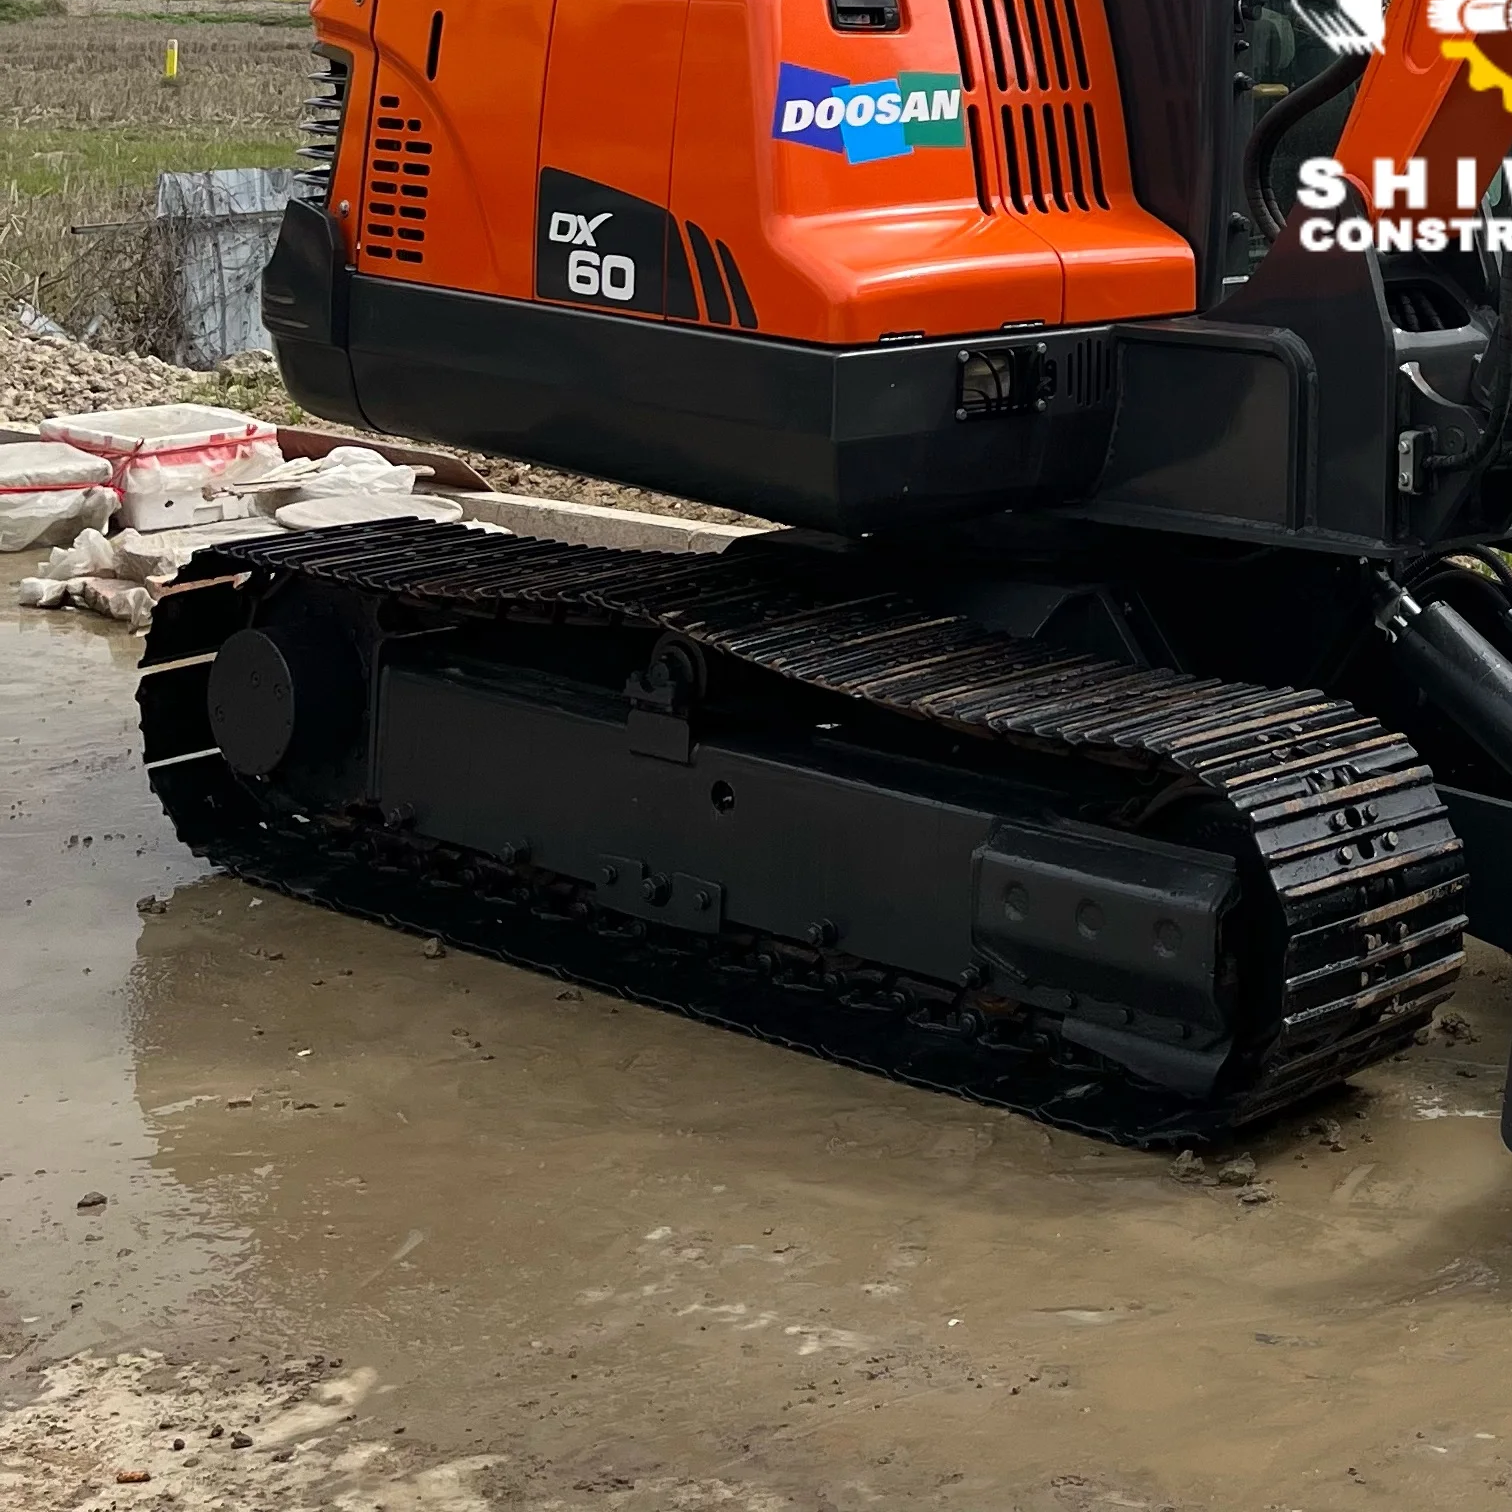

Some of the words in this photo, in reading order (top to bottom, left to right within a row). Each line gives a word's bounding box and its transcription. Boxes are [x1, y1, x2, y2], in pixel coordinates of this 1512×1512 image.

[781, 89, 960, 133] DOOSAN
[549, 212, 613, 247] DX
[568, 250, 635, 301] 60
